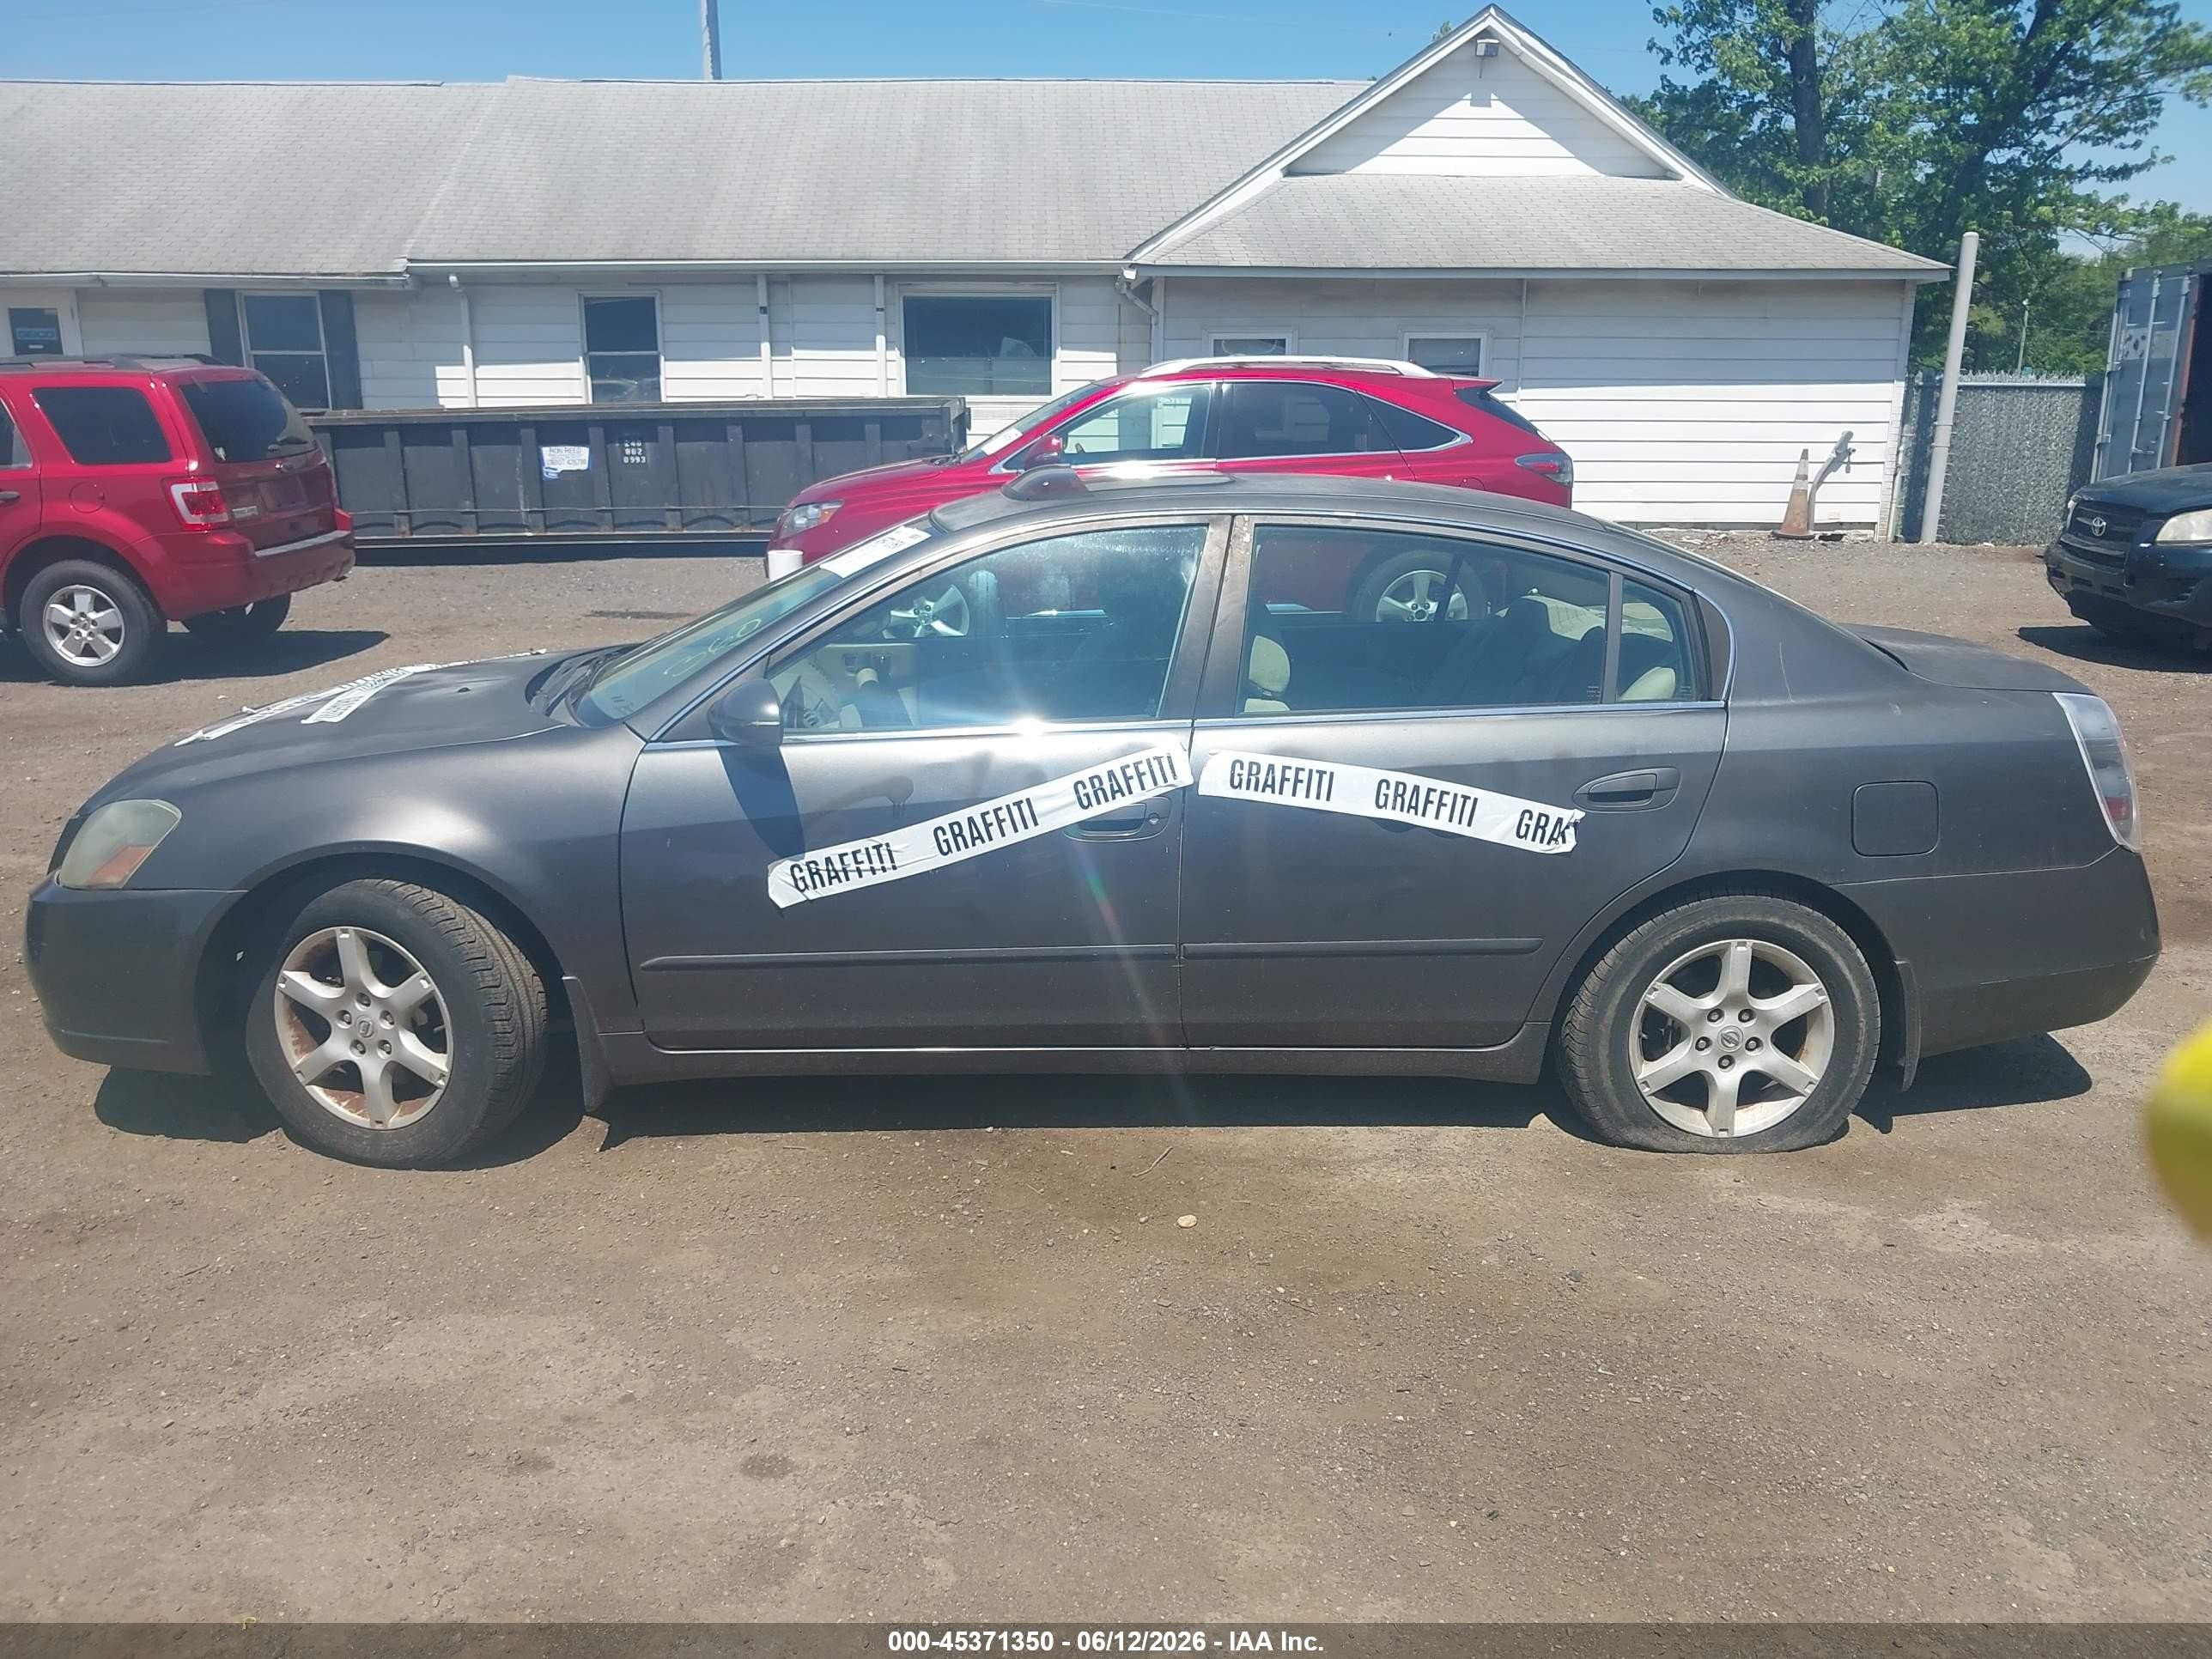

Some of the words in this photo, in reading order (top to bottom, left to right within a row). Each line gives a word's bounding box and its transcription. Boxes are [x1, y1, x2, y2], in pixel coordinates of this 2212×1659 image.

[790, 842, 898, 893] GRAFFITI
[933, 798, 1040, 856] GRAFFITI
[1073, 753, 1178, 810] GRAFFITI
[1230, 759, 1334, 802] GRAFFITI
[1375, 779, 1479, 828] GRAFFITI
